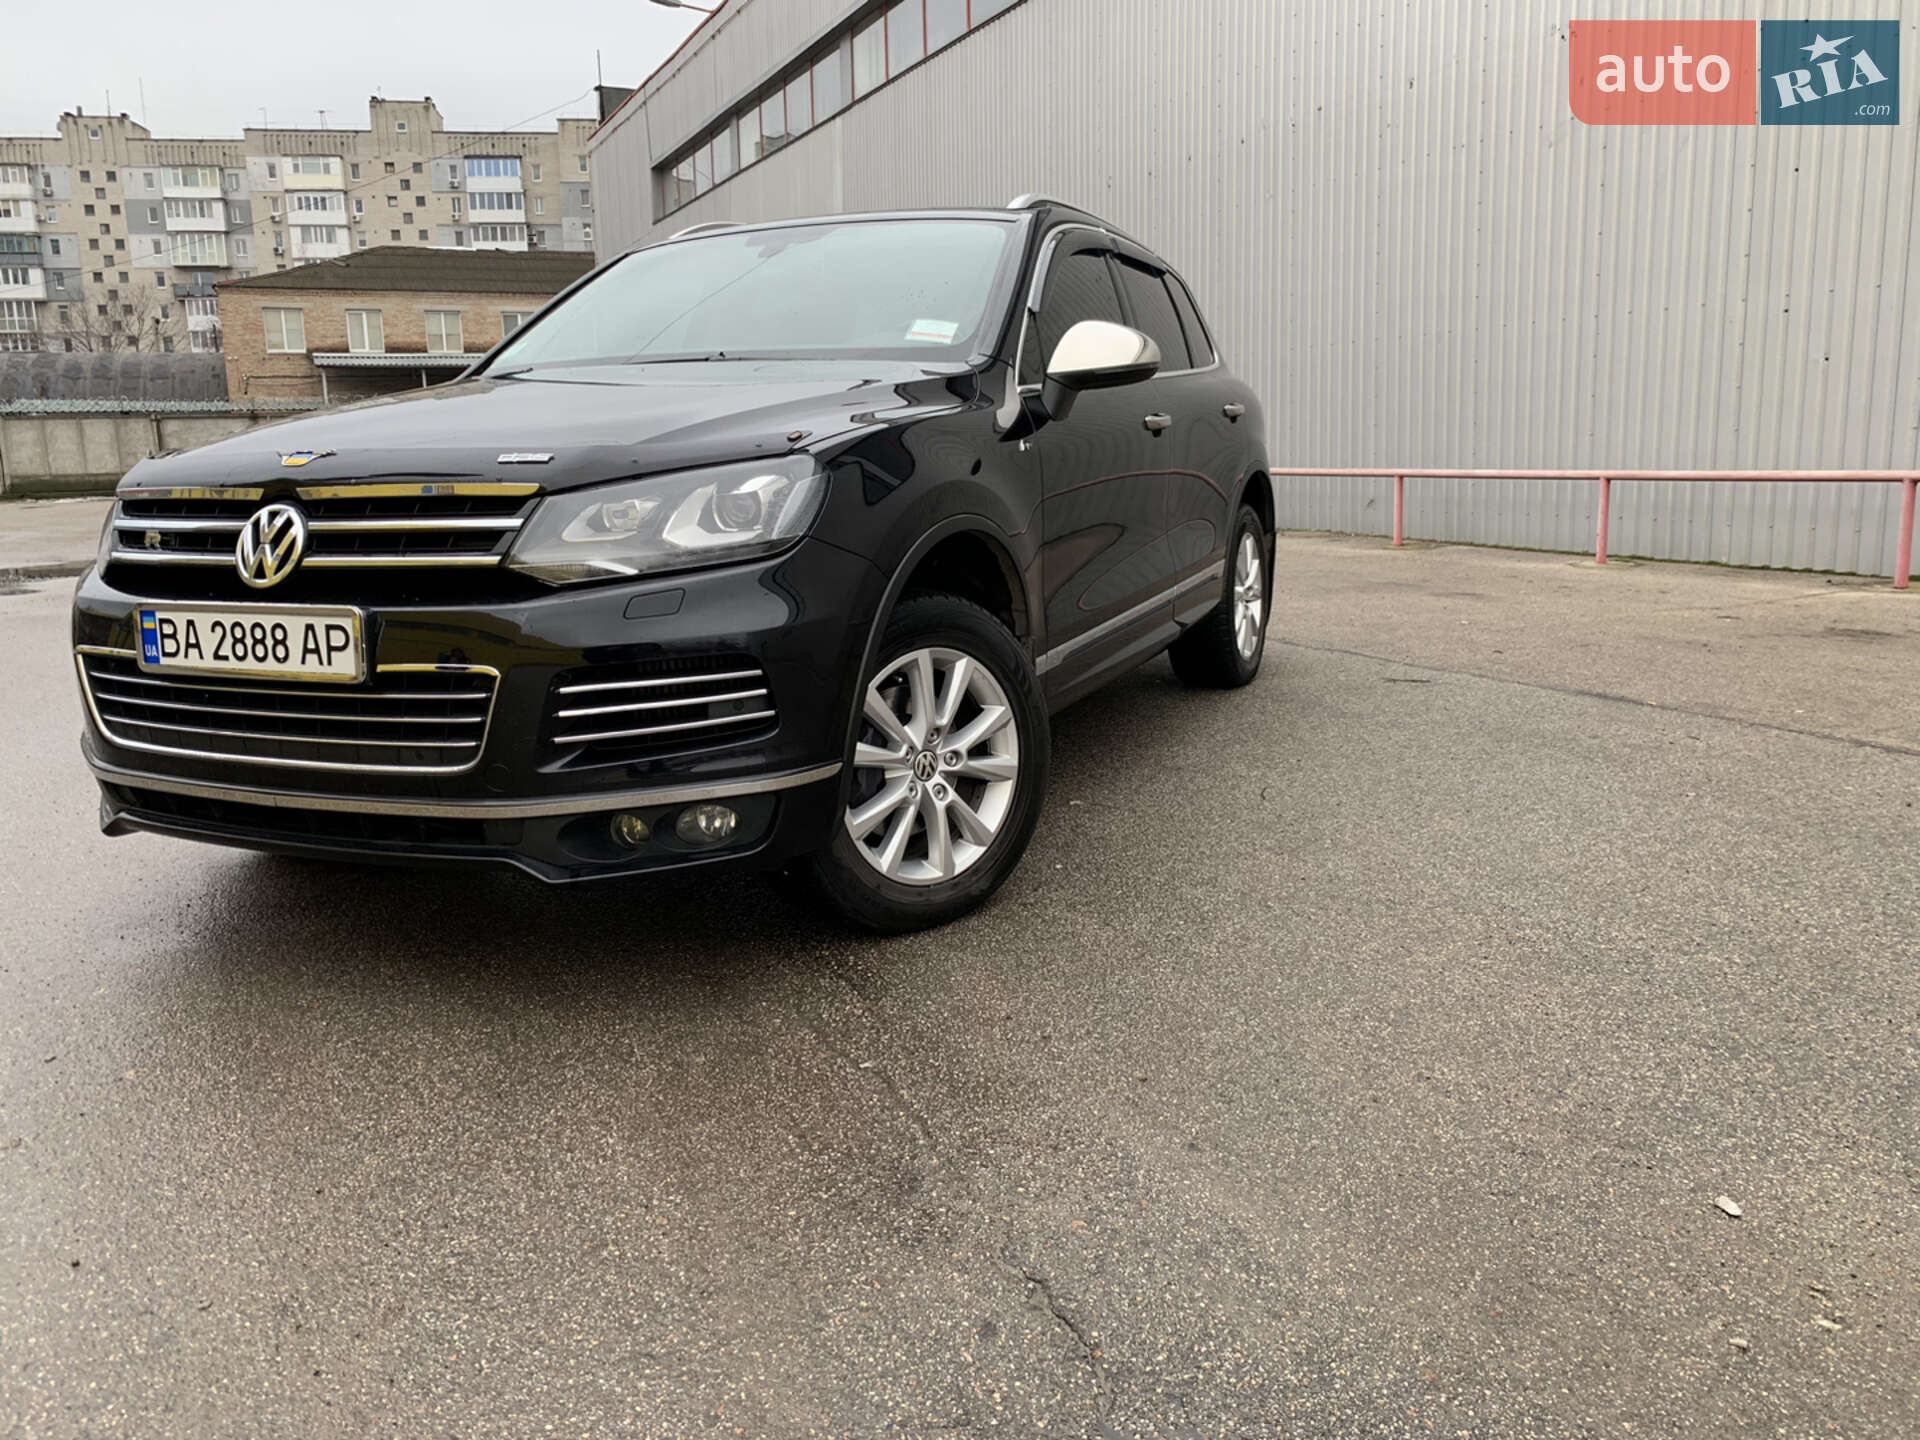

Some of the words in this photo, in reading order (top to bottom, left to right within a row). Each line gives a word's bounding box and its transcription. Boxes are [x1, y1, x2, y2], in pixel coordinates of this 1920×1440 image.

[144, 644, 158, 657] UA
[158, 617, 204, 660] BA
[210, 620, 290, 664] 2888
[300, 623, 350, 666] AP
